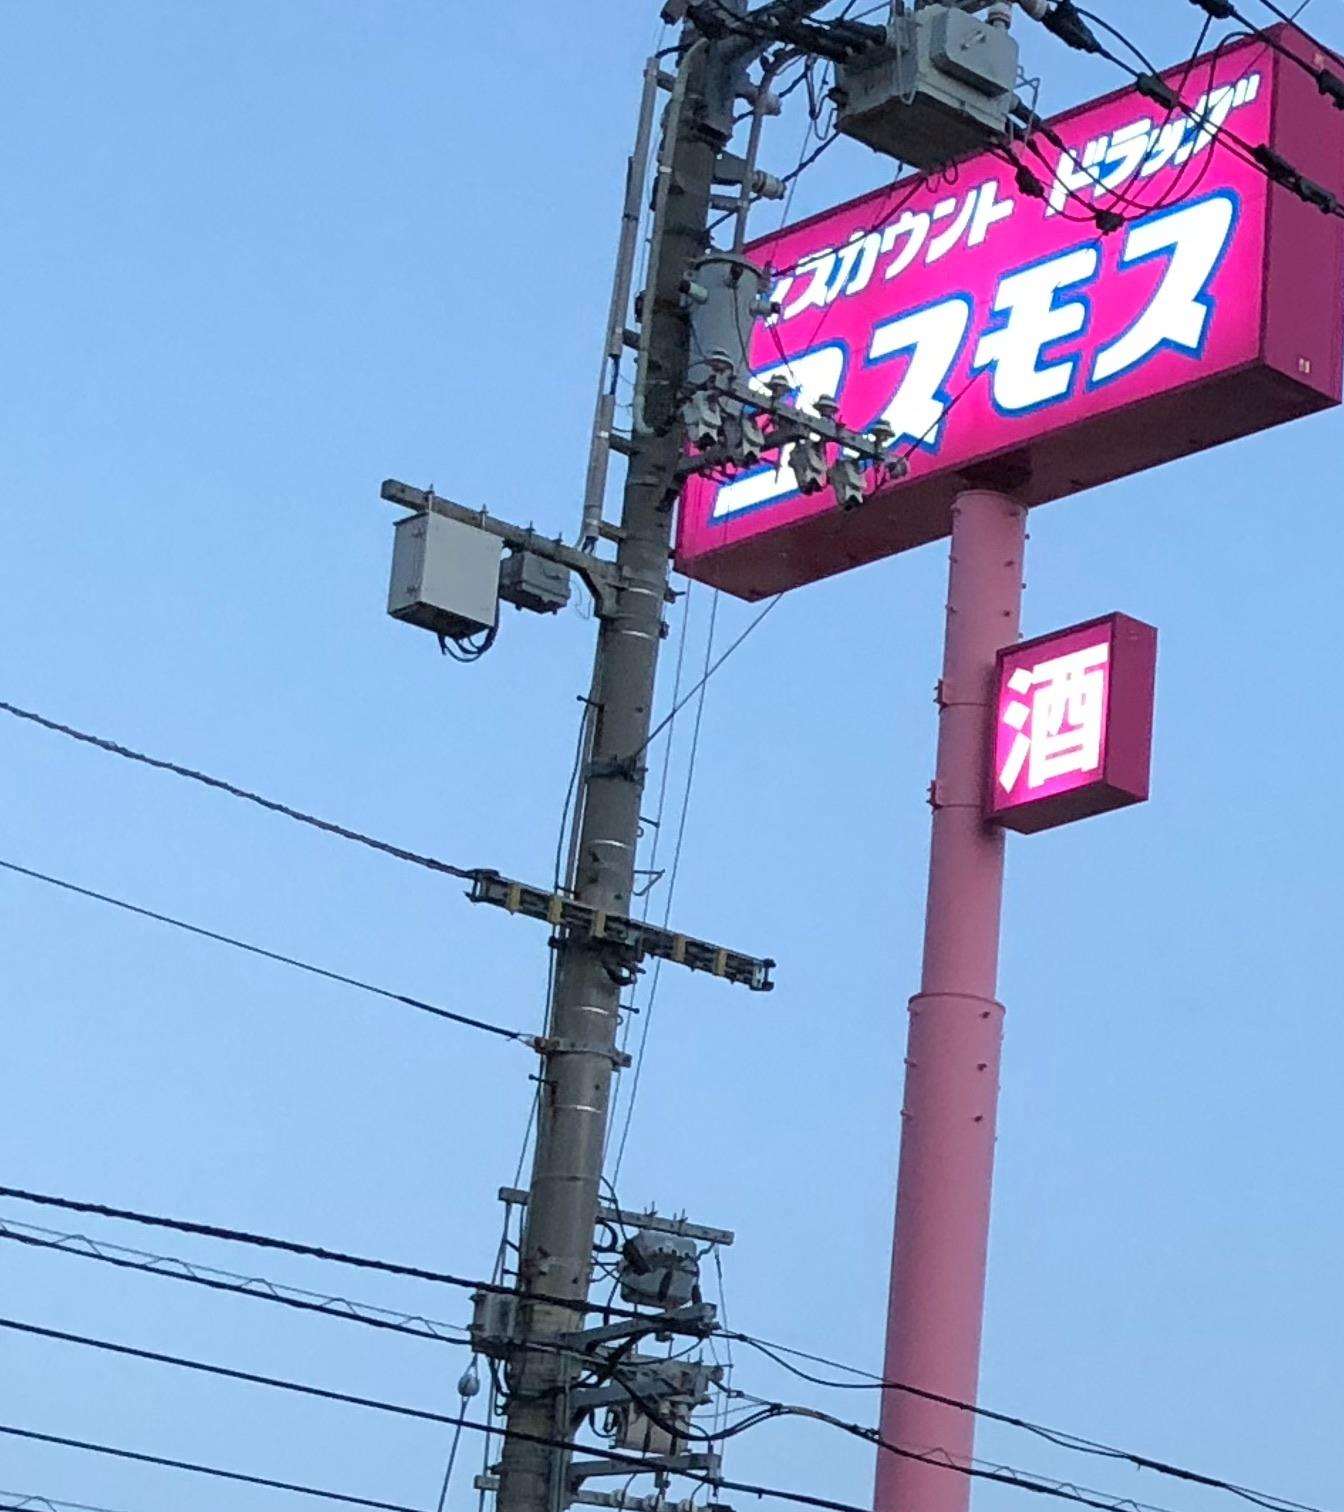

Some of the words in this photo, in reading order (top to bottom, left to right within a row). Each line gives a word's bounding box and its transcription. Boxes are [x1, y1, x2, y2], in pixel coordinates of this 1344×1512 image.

[1046, 73, 1260, 215] ドラッグ
[712, 190, 1238, 525] コスモス
[999, 641, 1110, 793] 酒
